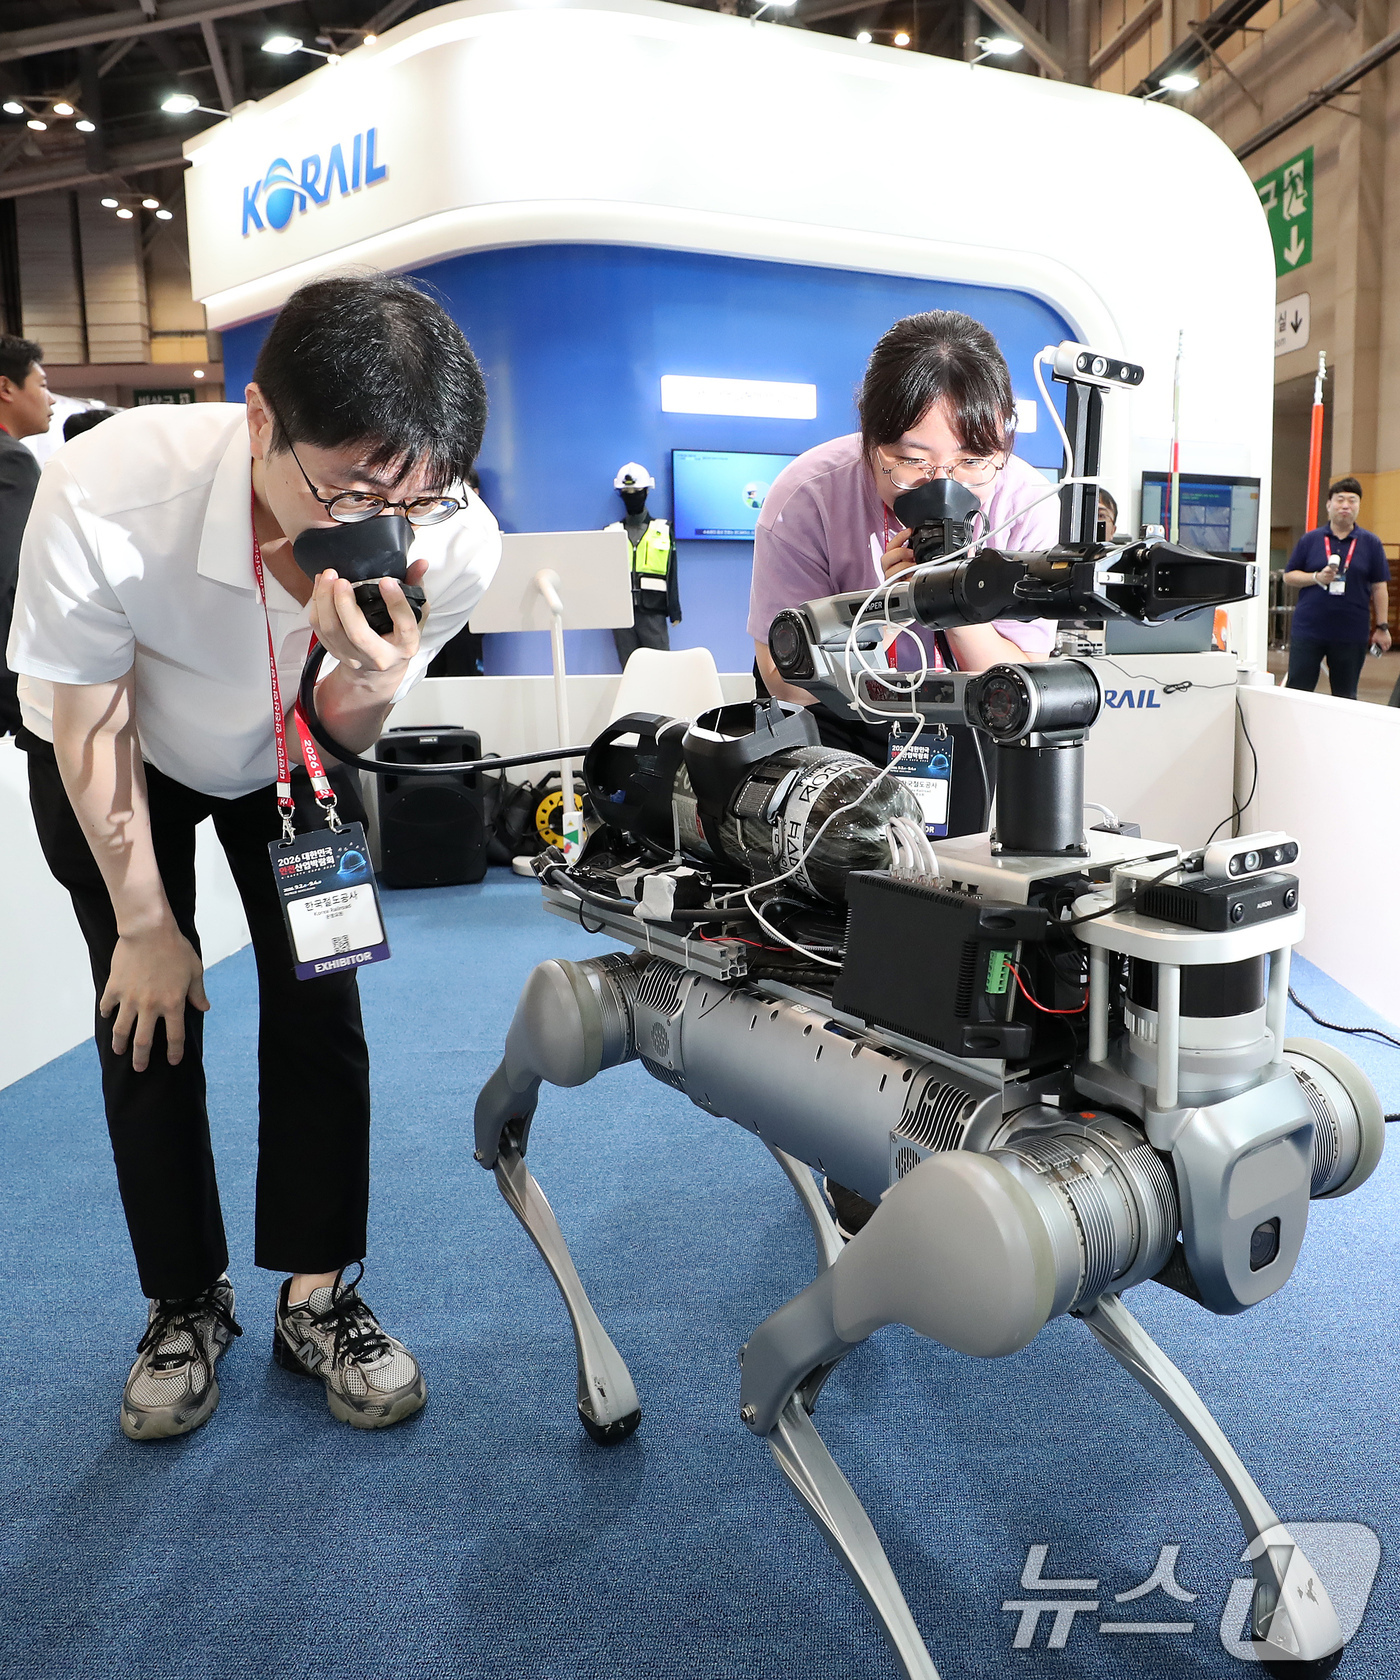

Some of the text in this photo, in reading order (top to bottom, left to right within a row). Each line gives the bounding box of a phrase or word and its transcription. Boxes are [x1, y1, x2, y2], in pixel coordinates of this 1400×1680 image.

[242, 127, 387, 236] KORAIL
[1104, 689, 1161, 709] RAIL
[303, 739, 316, 771] 2026
[278, 846, 333, 867] 2026 대한민국
[305, 891, 358, 912] 한국철도공사
[314, 951, 373, 973] EXHIBITOR
